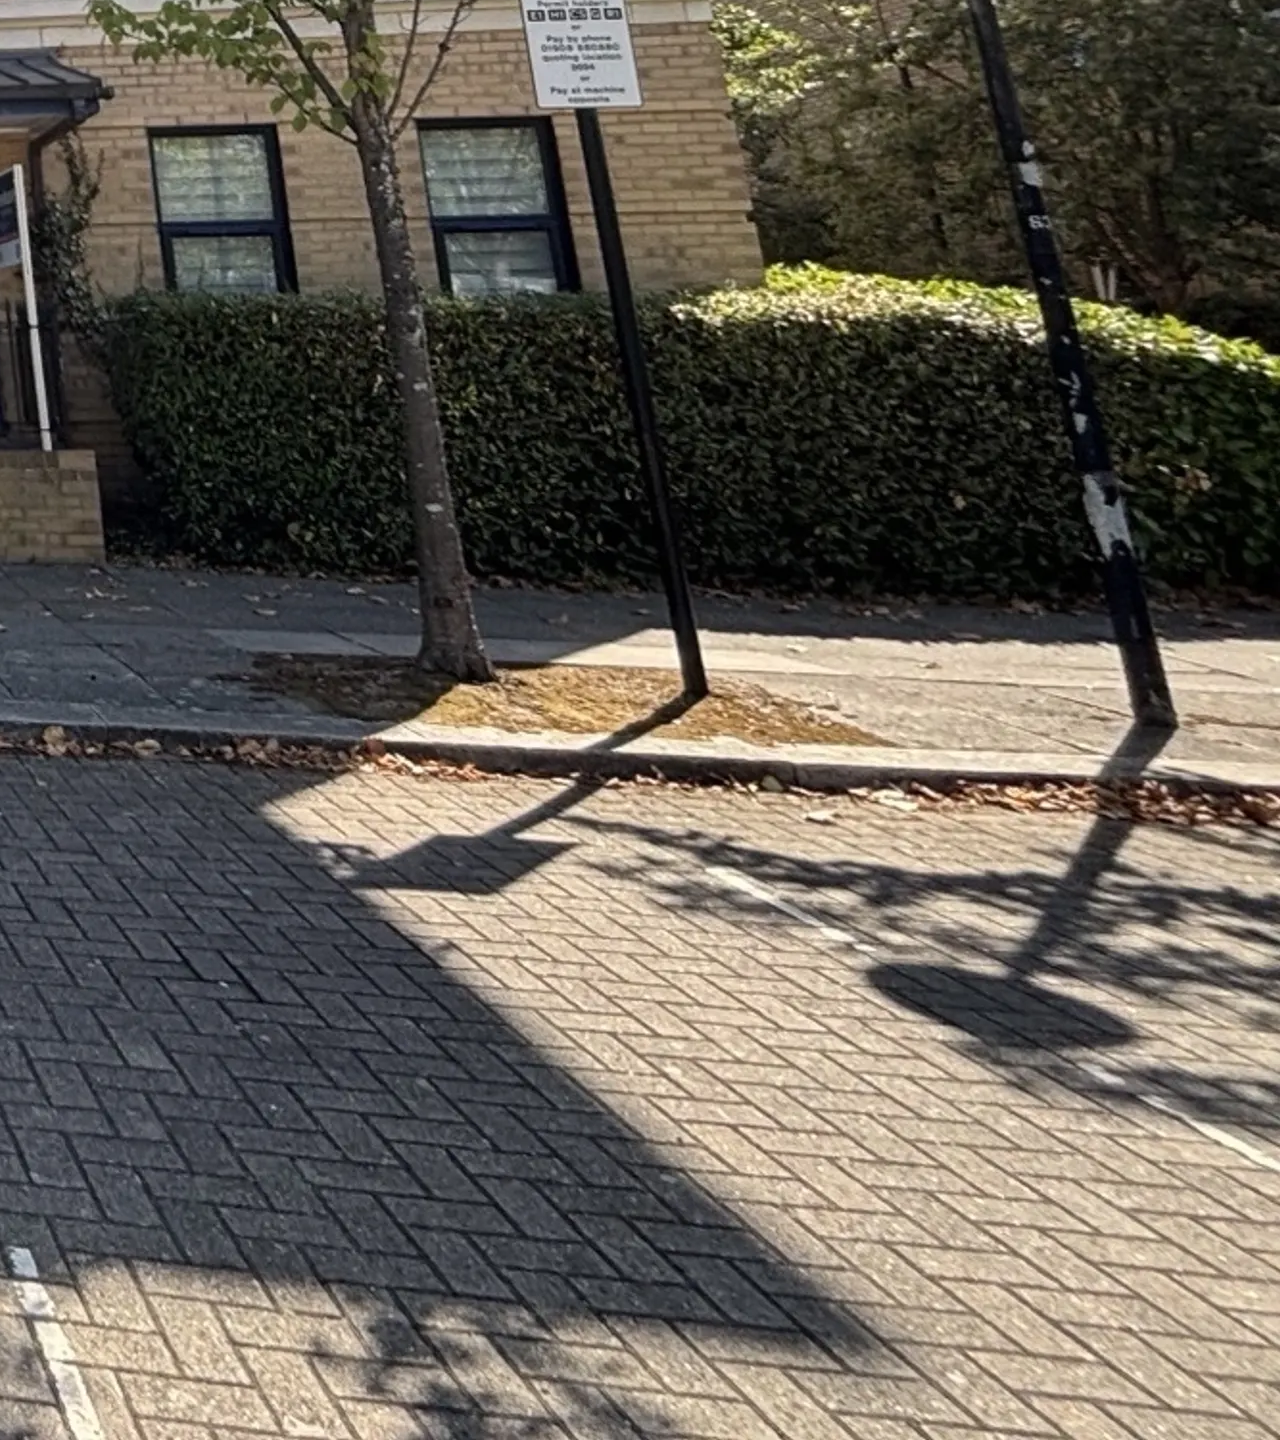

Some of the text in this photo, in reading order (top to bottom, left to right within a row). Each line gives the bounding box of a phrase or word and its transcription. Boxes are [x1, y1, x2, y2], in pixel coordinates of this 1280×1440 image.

[536, 0, 609, 8] Permit holders
[570, 23, 582, 31] or
[545, 34, 612, 43] Pay by phone
[542, 53, 623, 62] quoting location
[549, 85, 626, 95] Pay at machine
